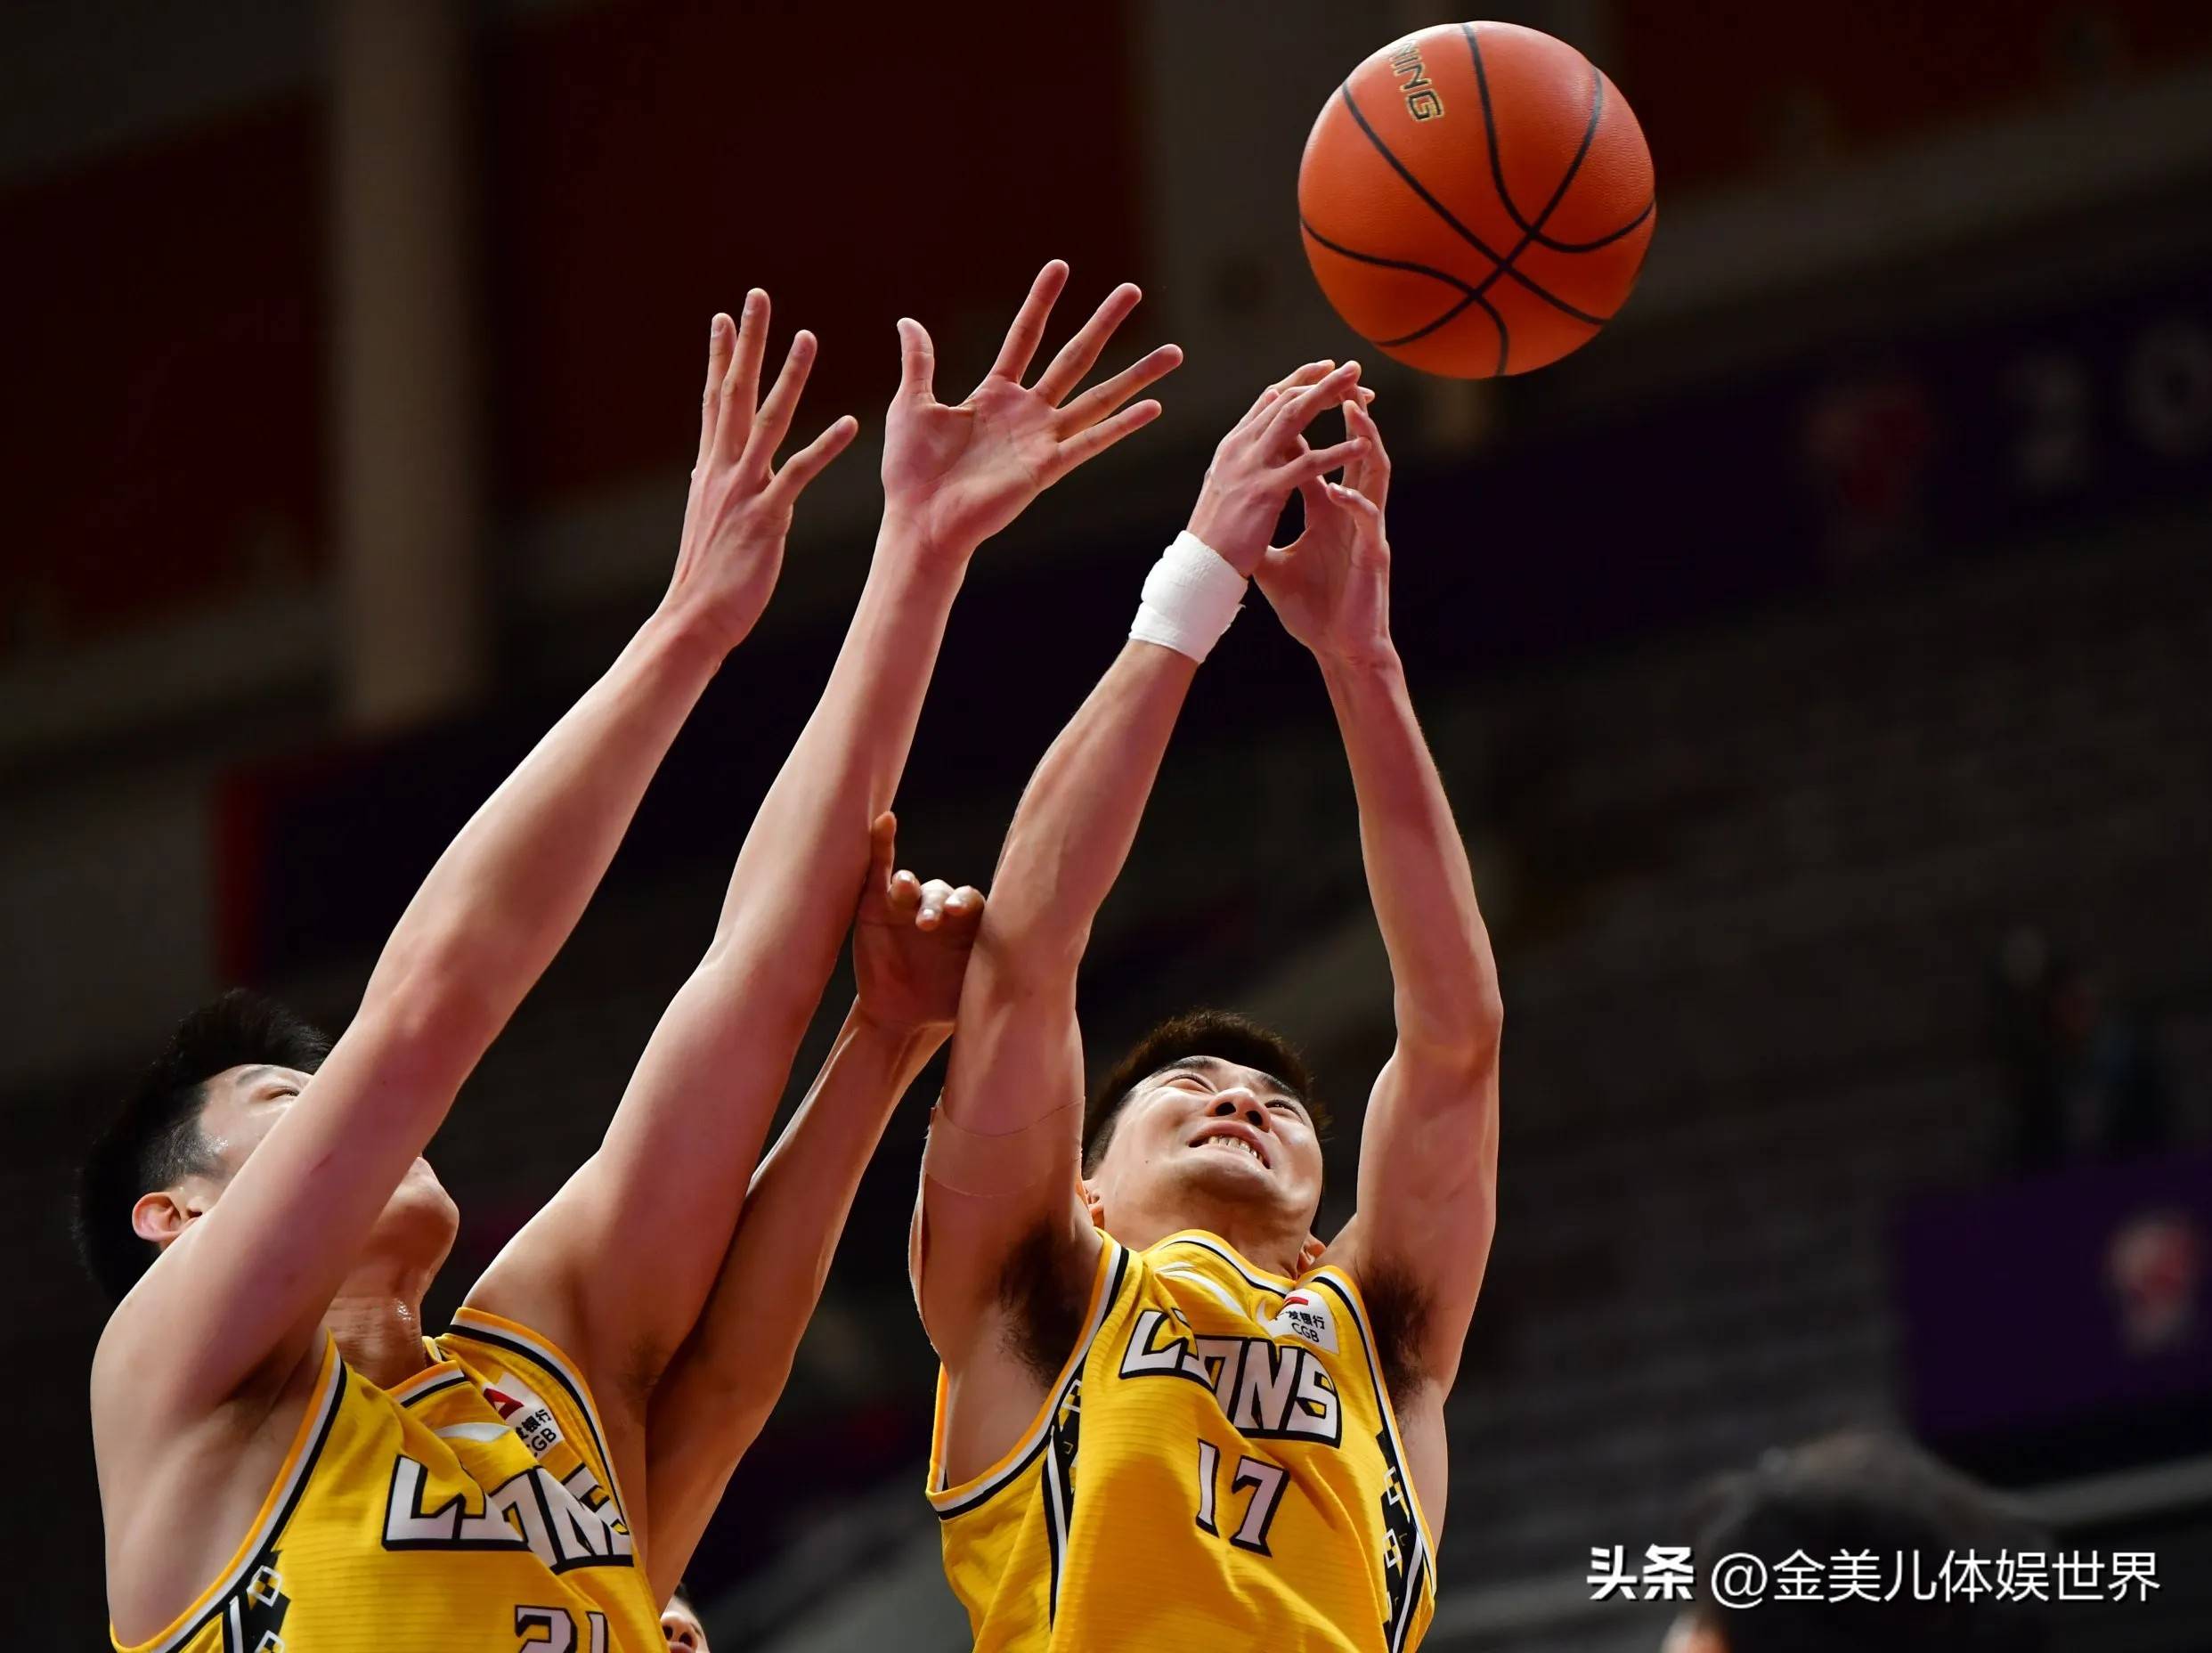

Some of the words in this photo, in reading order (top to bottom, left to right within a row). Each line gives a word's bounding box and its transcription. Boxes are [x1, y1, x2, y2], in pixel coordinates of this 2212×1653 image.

[1291, 1323, 1320, 1343] CGB
[527, 1428, 557, 1458] GB
[1195, 1437, 1290, 1559] 17
